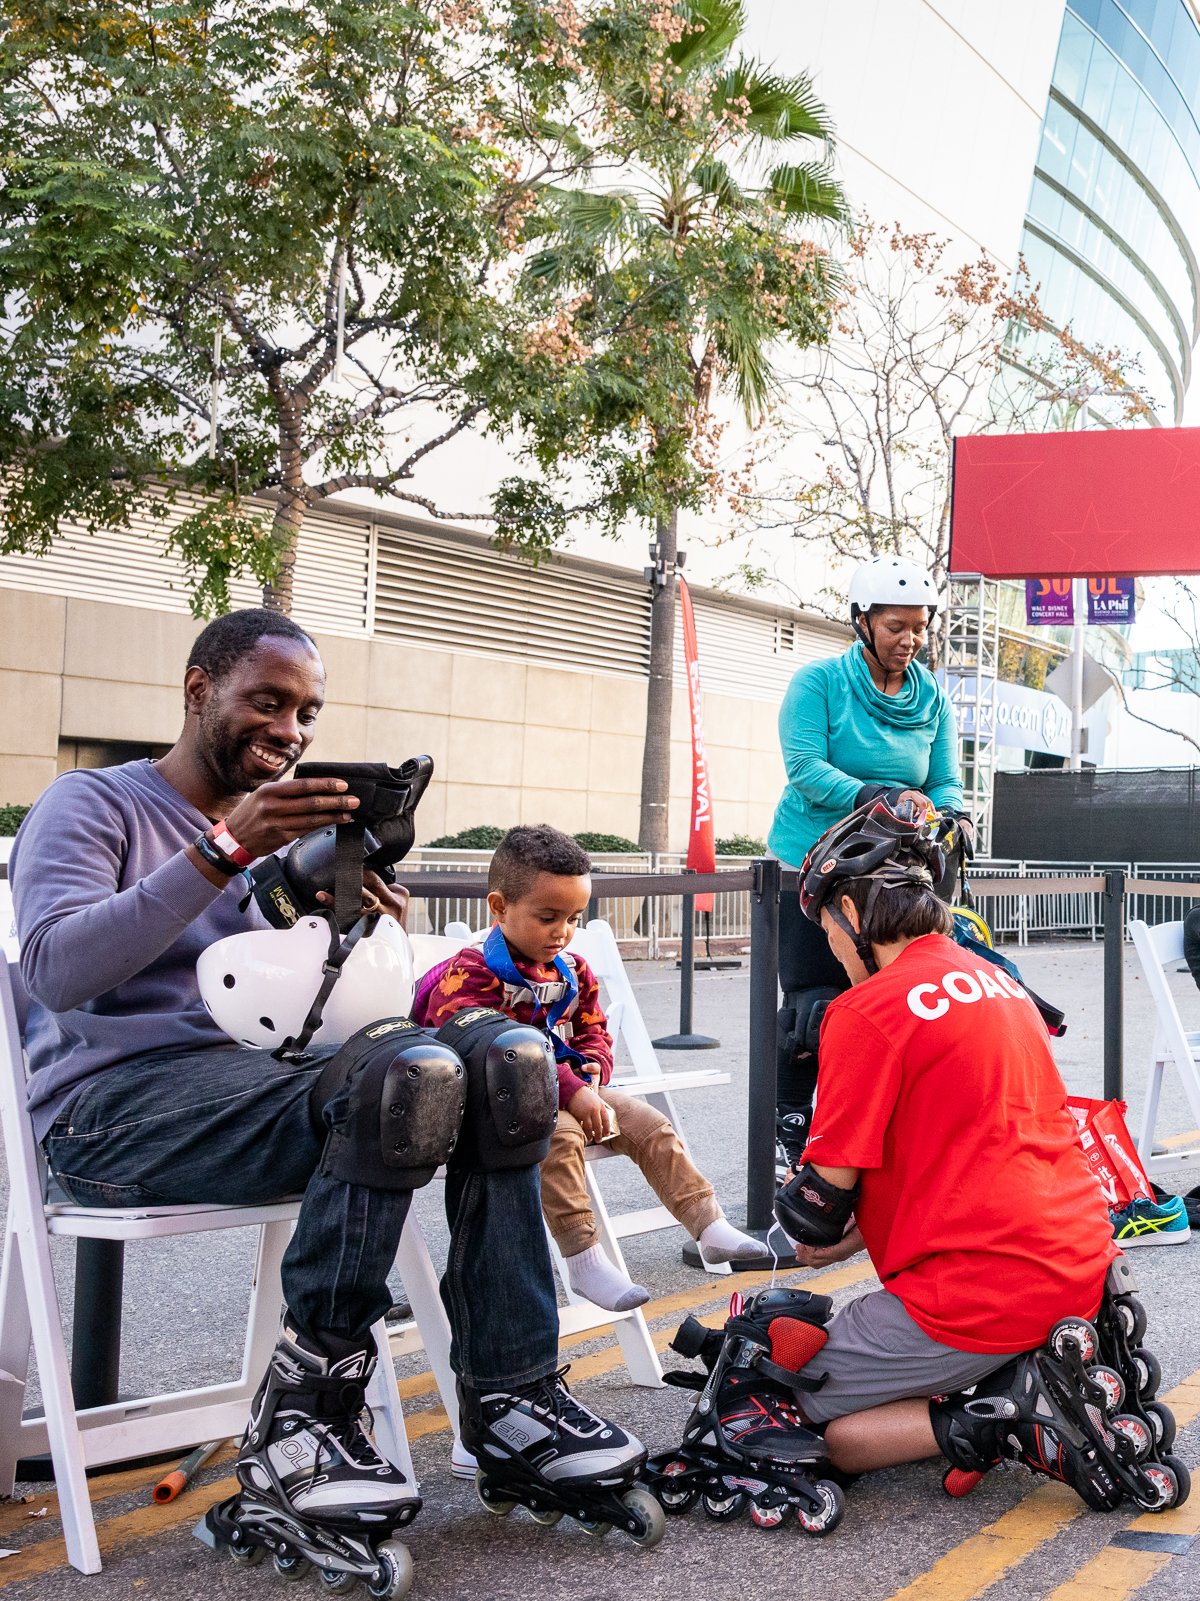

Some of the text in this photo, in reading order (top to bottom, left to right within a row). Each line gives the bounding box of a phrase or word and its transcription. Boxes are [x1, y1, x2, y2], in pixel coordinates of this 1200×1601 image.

[1094, 599, 1129, 611] LA Phil
[822, 860, 836, 872] BELL
[907, 968, 1031, 1021] COAC
